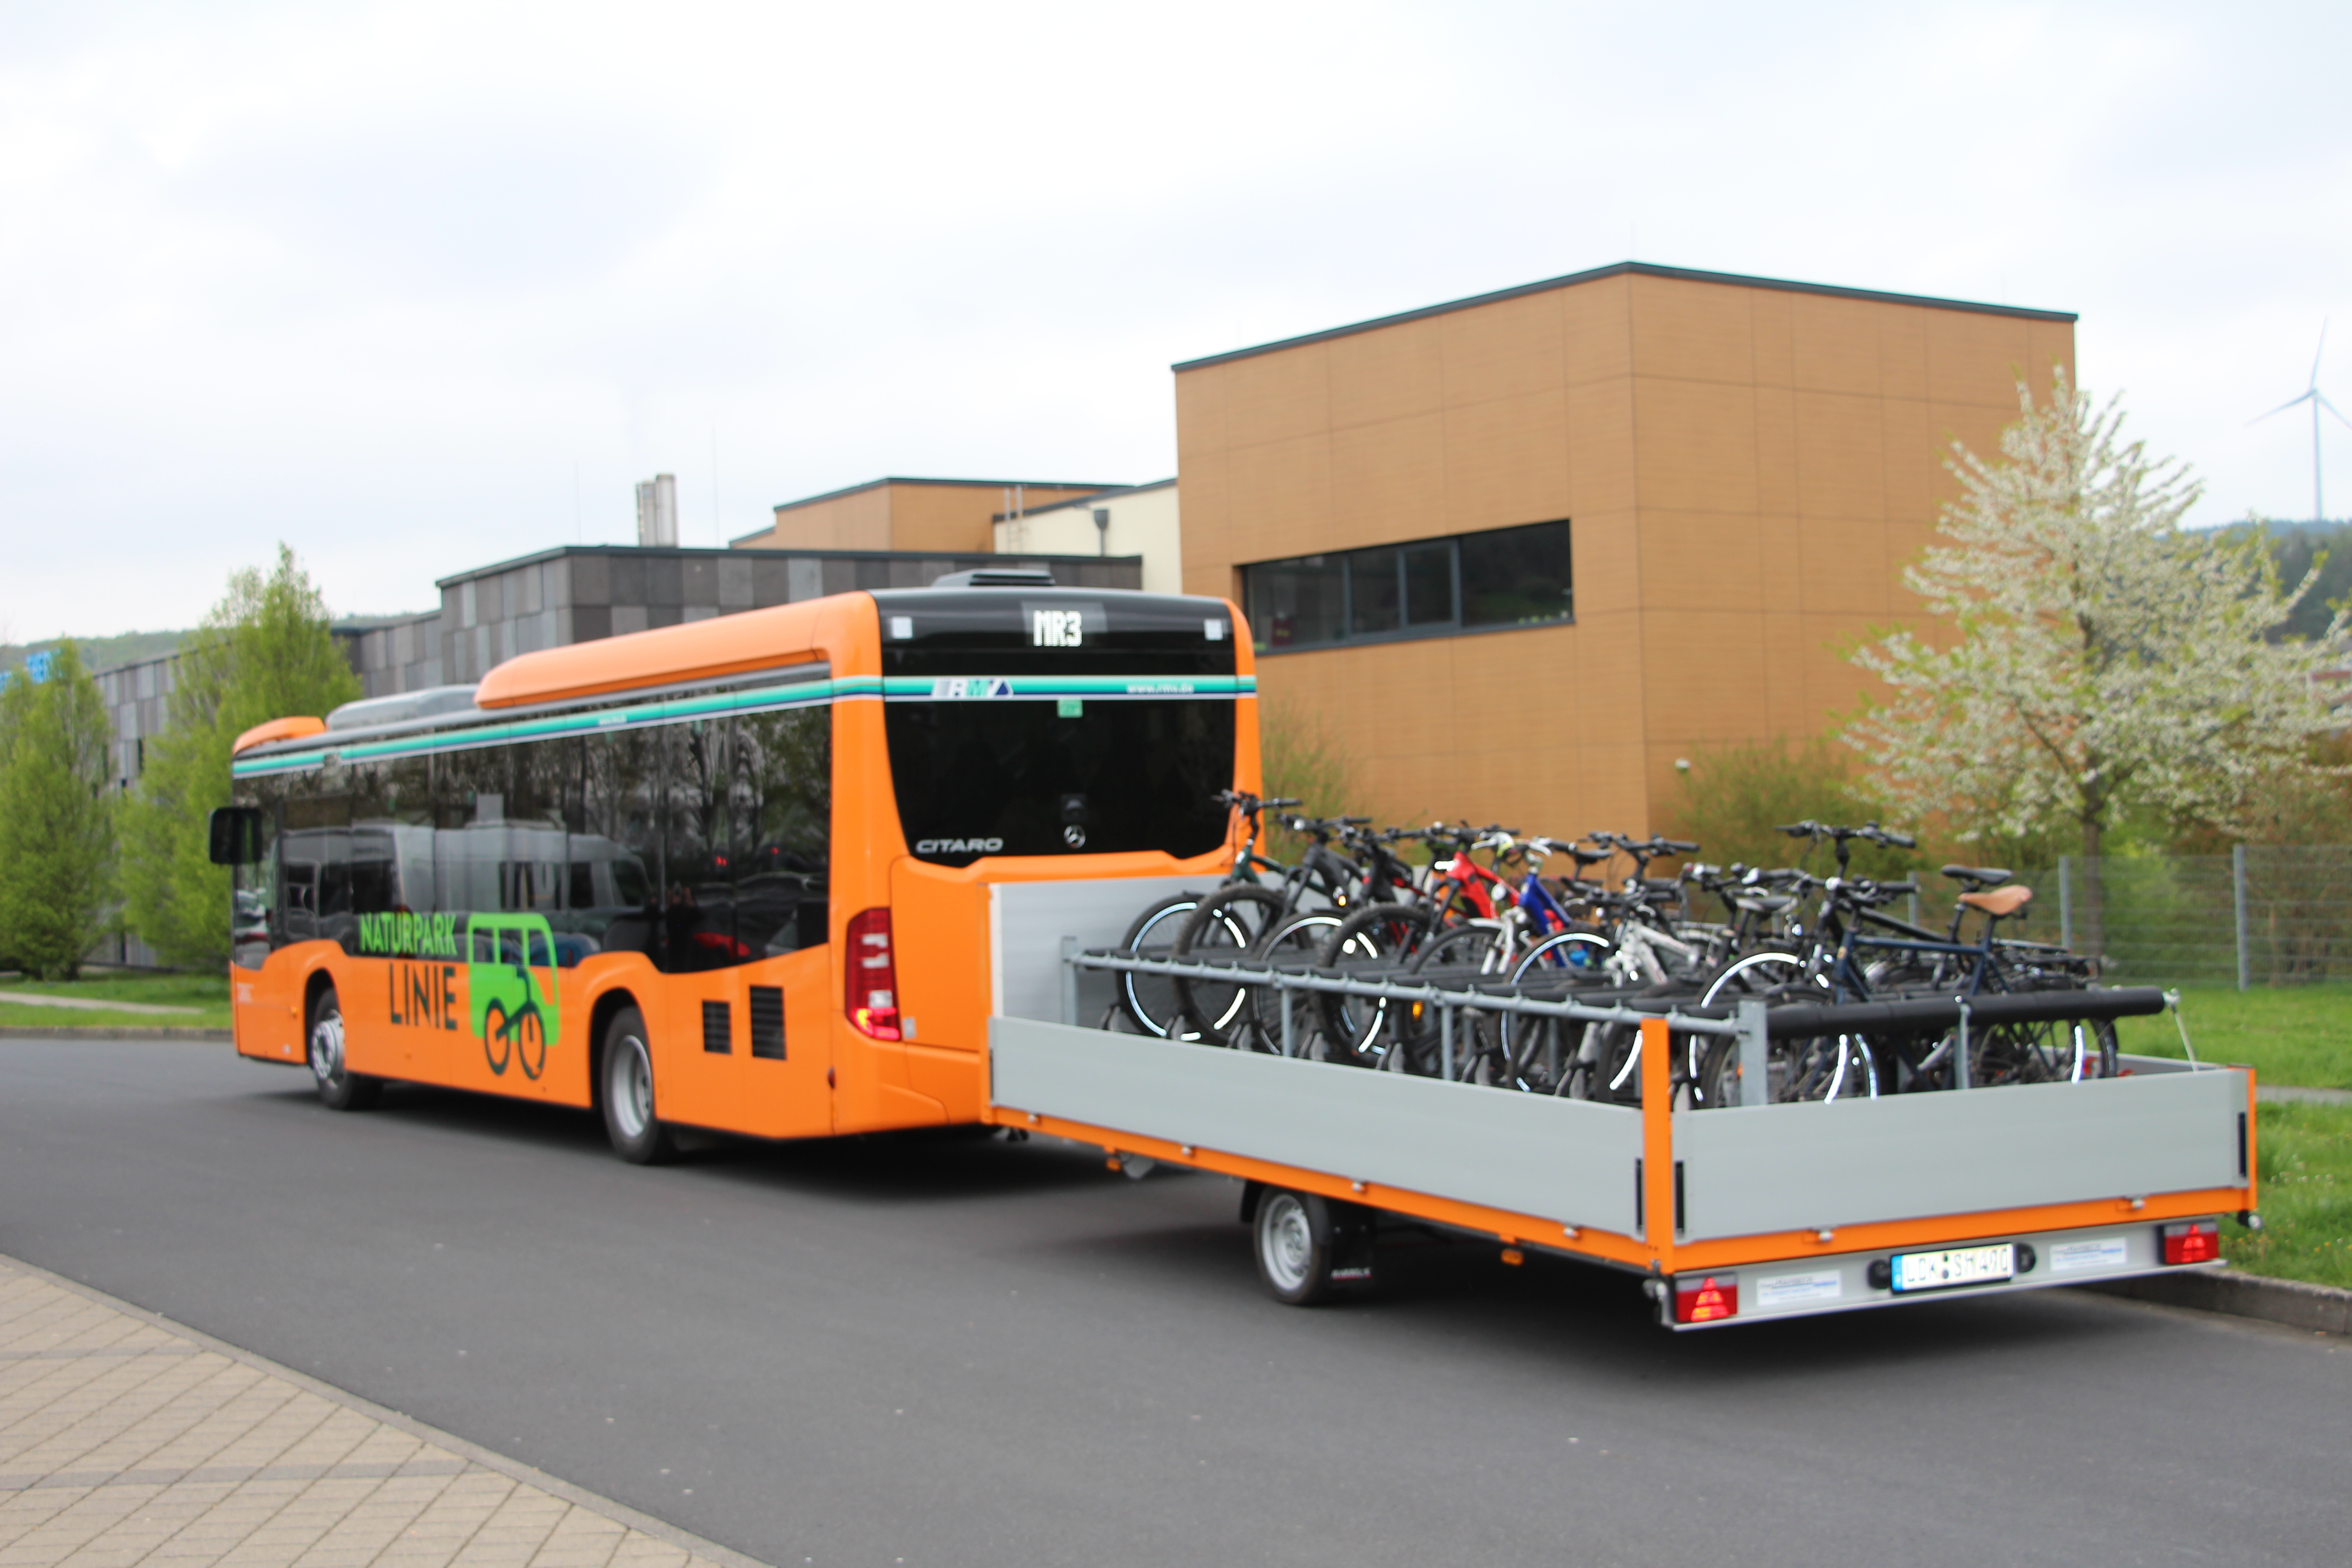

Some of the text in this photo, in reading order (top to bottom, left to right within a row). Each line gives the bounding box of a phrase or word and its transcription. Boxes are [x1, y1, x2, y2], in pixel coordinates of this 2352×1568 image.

[1033, 610, 1083, 647] MR3
[915, 837, 1004, 854] CITARO
[359, 911, 458, 956] NATURPARK
[389, 962, 458, 1031] LINIE
